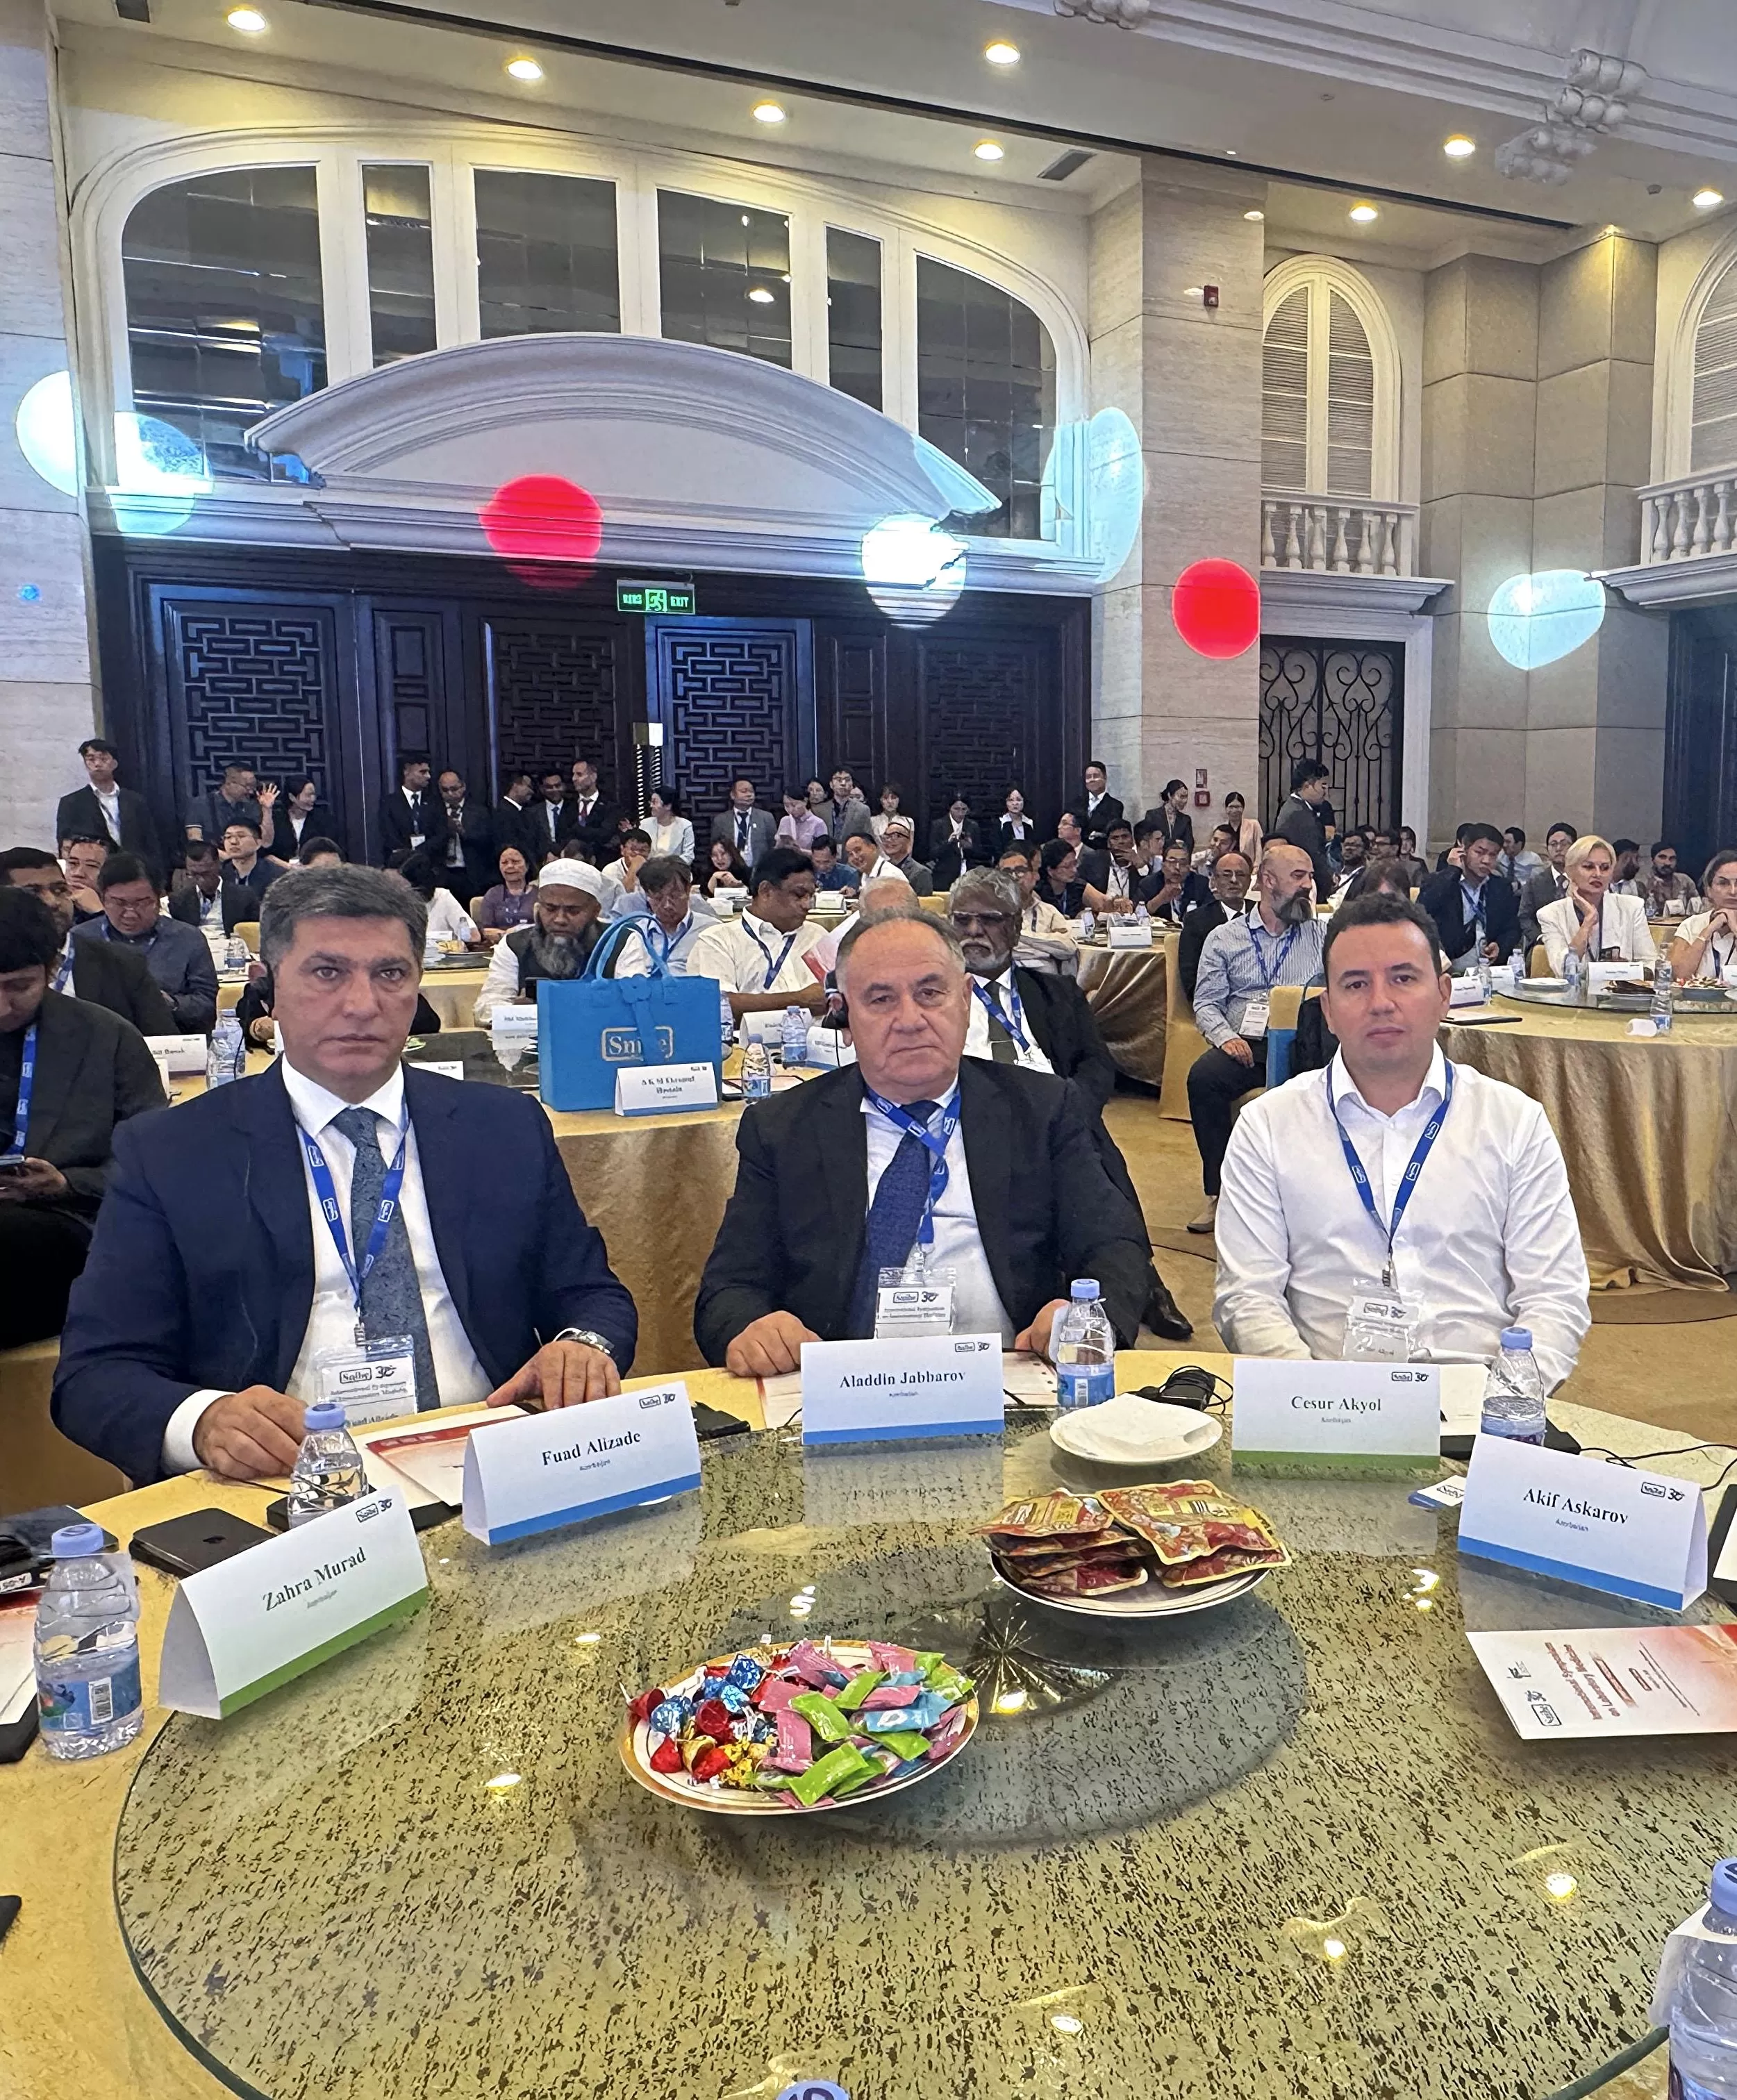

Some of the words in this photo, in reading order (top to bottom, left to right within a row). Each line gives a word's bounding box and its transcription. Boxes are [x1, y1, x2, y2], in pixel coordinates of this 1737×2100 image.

[670, 596, 689, 608] EXIT
[840, 1373, 896, 1389] Aladdin
[900, 1370, 966, 1385] Jabbarov
[1291, 1396, 1334, 1410] Cesur
[1339, 1397, 1382, 1415] Akyol
[542, 1443, 581, 1466] Fuad
[586, 1430, 642, 1456] Alizade
[1522, 1488, 1561, 1510] Akif
[1561, 1497, 1630, 1525] Askarov
[262, 1577, 313, 1612] Zahra
[313, 1547, 367, 1585] Murad
